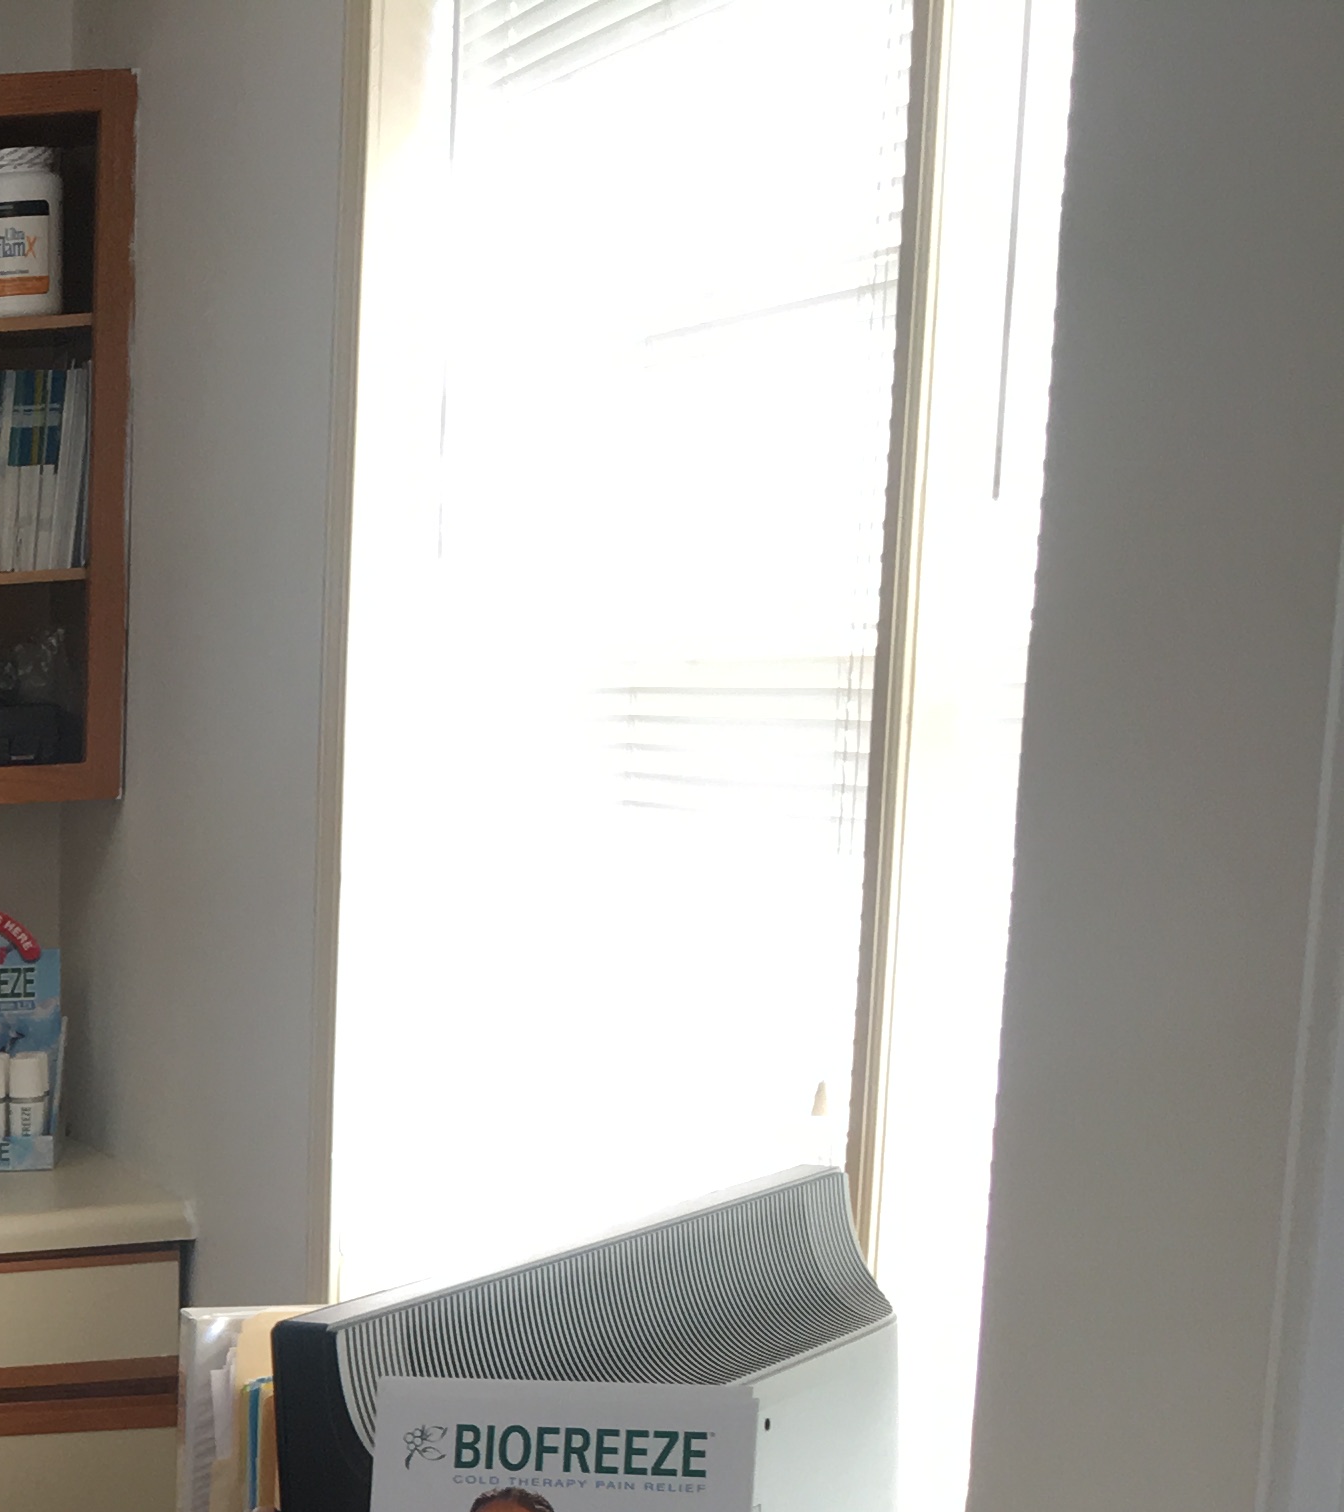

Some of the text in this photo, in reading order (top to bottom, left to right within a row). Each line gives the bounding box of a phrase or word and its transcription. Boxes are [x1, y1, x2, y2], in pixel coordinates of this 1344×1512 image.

[4, 921, 33, 951] HERE
[454, 1424, 708, 1478] BIOFREEZE
[453, 1475, 707, 1493] COLD THERAPY PAIN RELIEF
